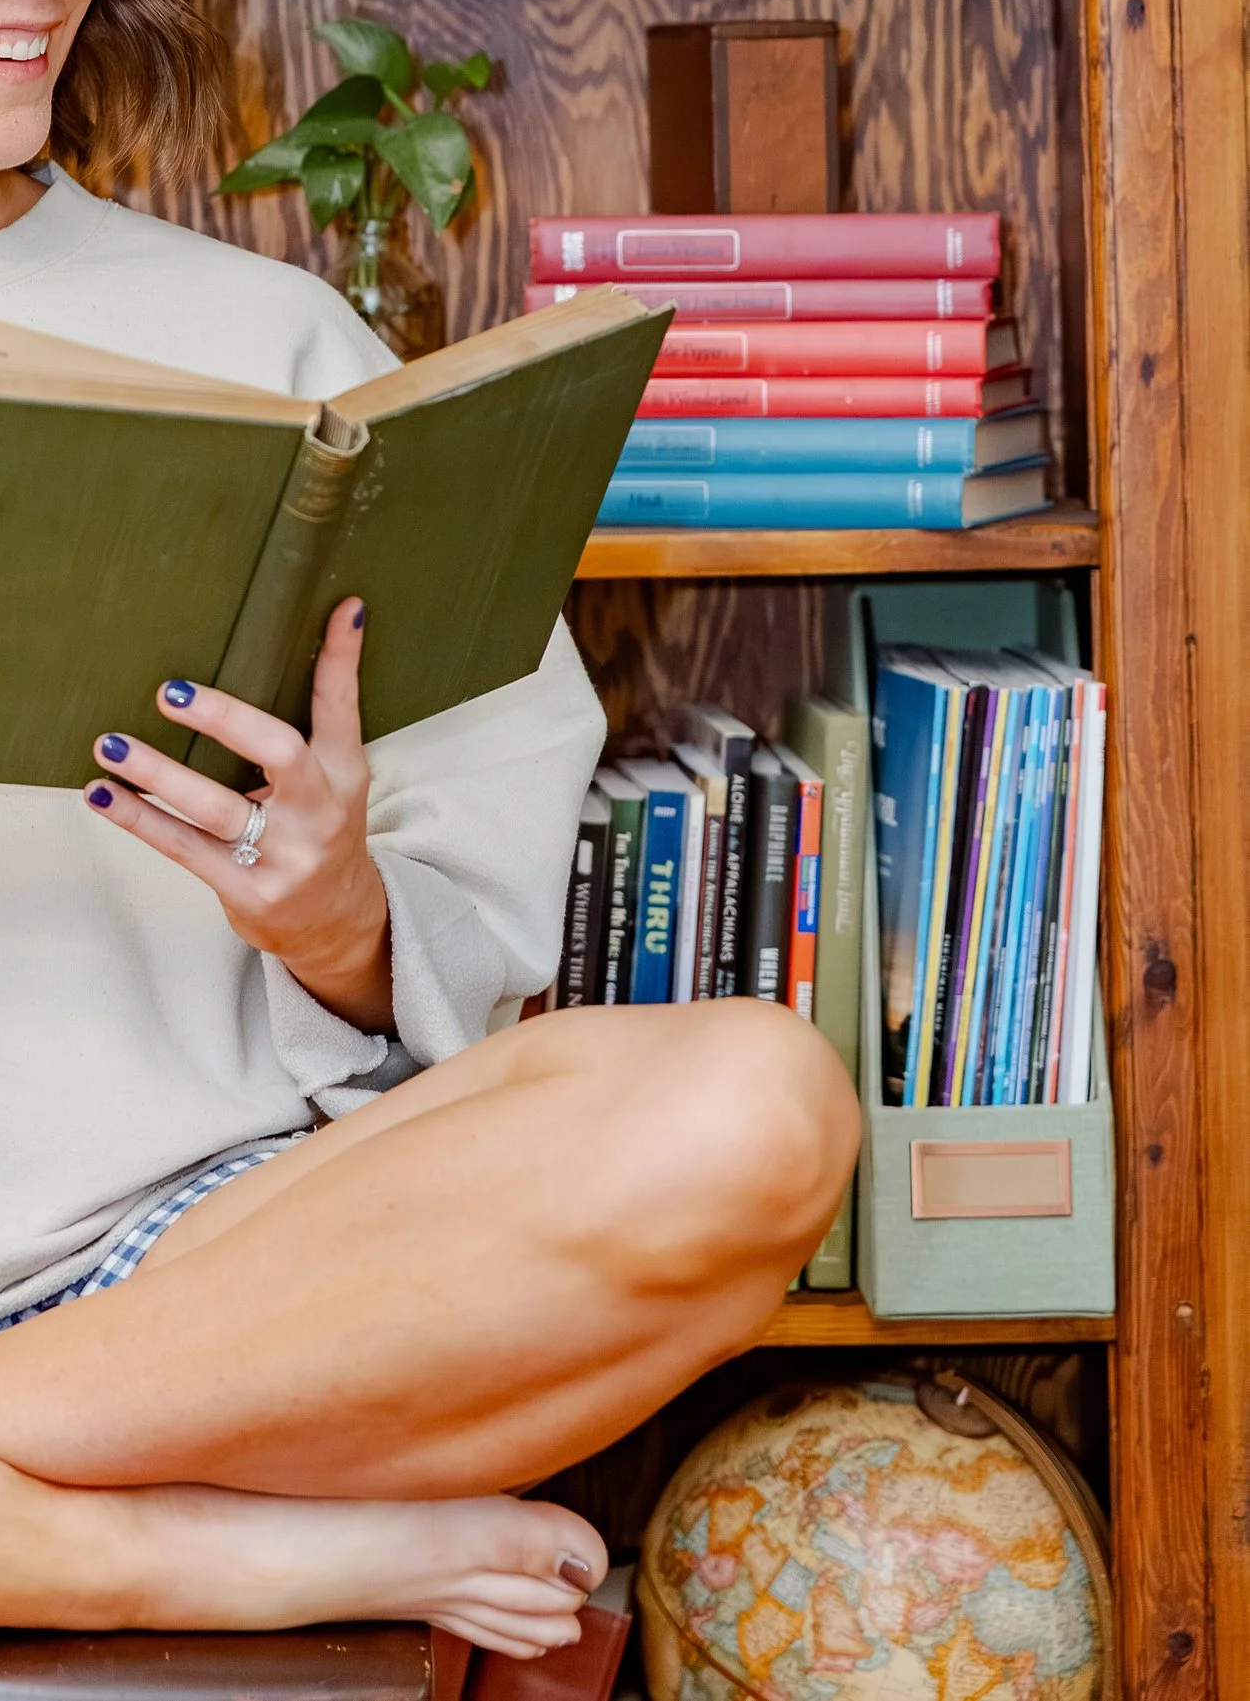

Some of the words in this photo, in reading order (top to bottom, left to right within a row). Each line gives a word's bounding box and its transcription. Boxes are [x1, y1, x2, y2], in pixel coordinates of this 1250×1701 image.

[730, 773, 746, 824] ALONE
[765, 804, 789, 882] DAUPHINEE
[570, 882, 592, 953] WHERE'S
[645, 859, 675, 955] THRU
[719, 851, 741, 963] APPALACHIANS
[568, 954, 585, 988] THE
[758, 948, 780, 990] WHEN
